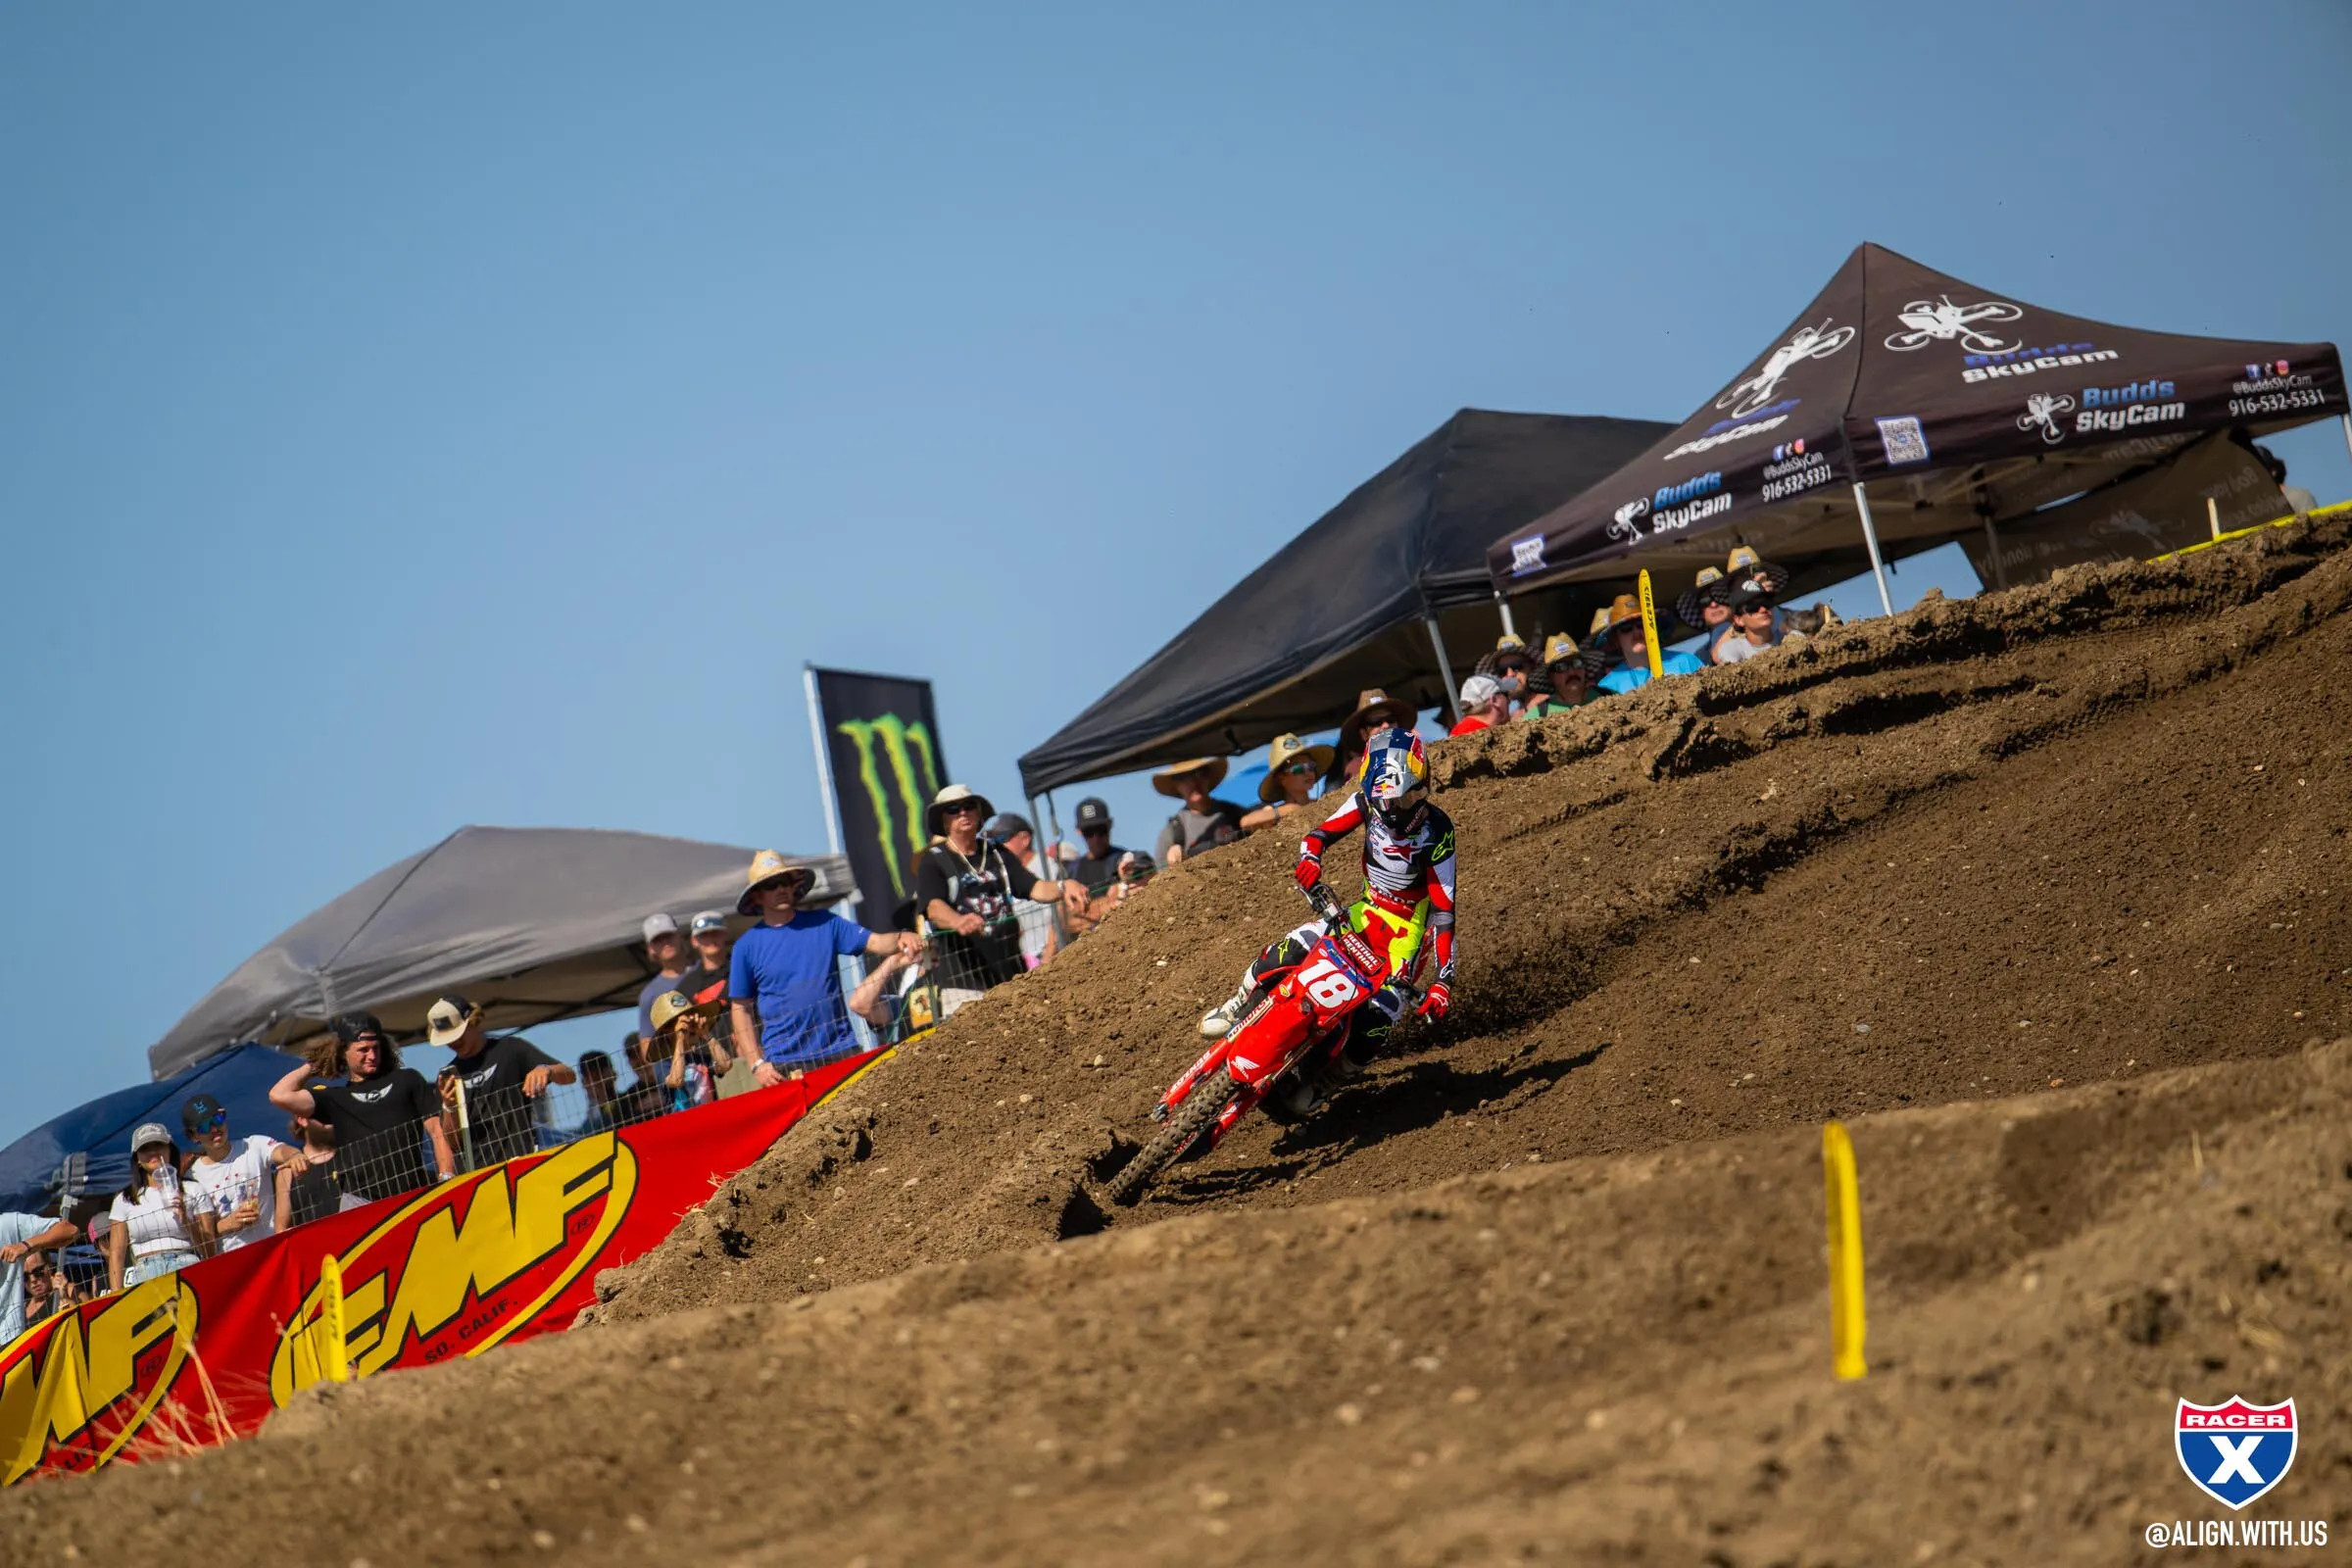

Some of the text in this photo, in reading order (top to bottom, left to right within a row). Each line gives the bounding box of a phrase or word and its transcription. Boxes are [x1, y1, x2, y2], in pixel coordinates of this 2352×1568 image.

[1961, 350, 2119, 383] SkyCam
[2232, 374, 2312, 394] @BuddsSkyCam
[2076, 402, 2185, 432] SkyCam
[2229, 388, 2326, 416] 916-532-5331
[1762, 465, 1832, 503] 916-532-5331
[1652, 492, 1733, 534] SkyCam
[1343, 939, 1373, 970] RENTHAL
[1347, 934, 1379, 965] RENTHAL
[1297, 958, 1359, 1008] 18
[293, 1129, 619, 1390] FMF
[423, 1298, 519, 1364] SO. CALIF.
